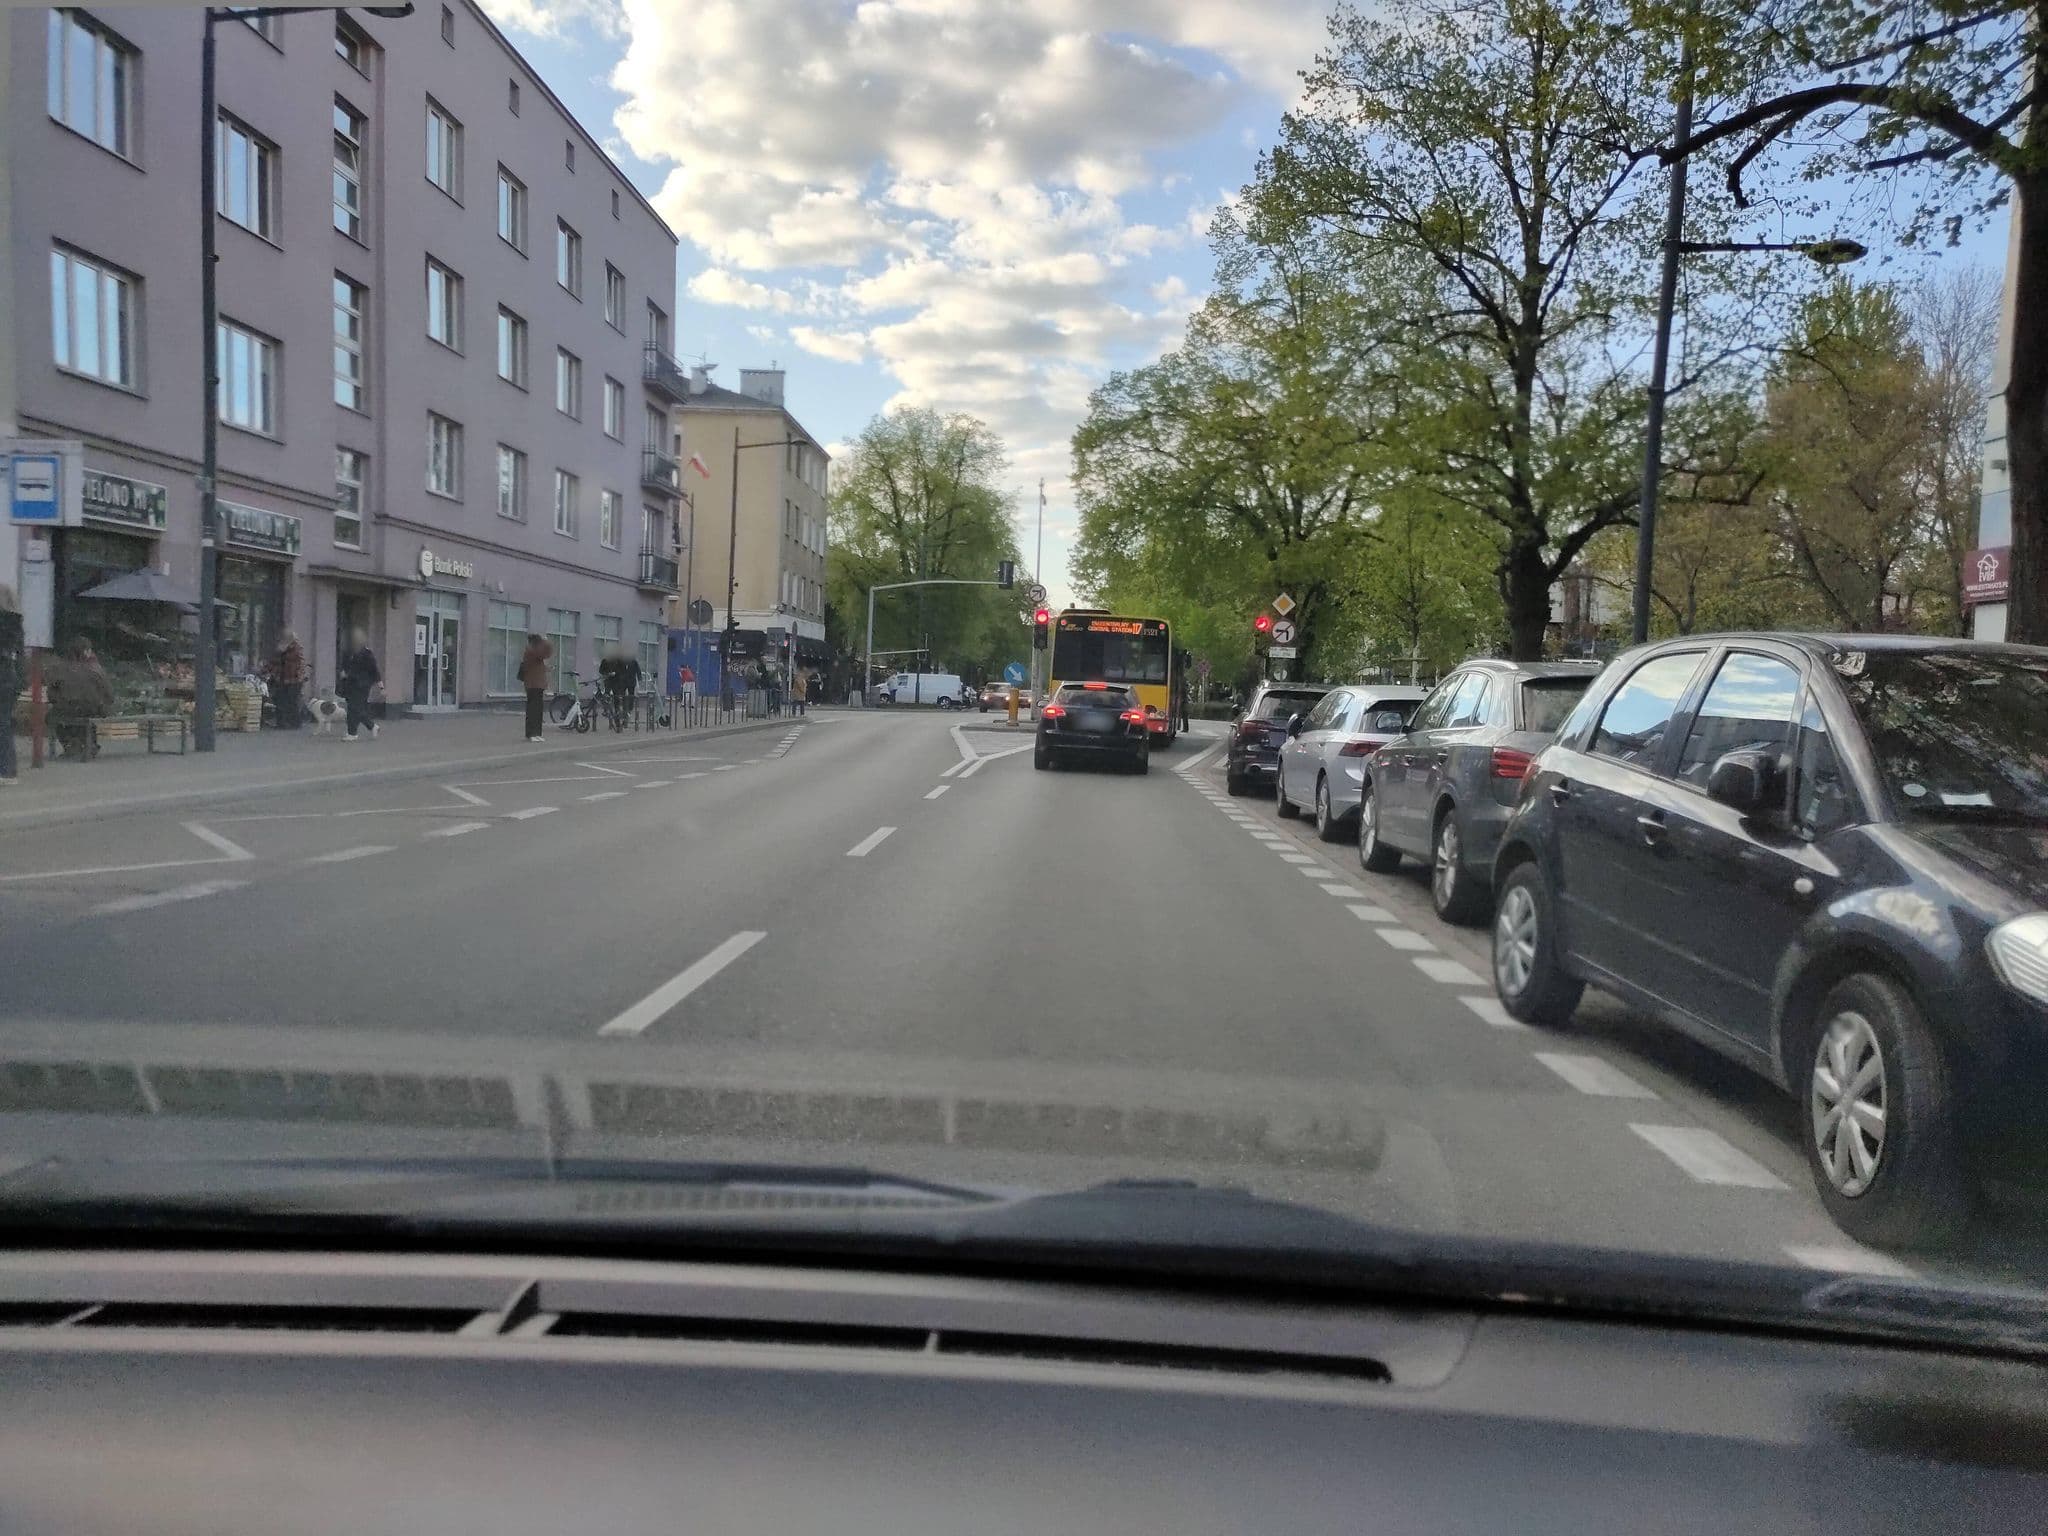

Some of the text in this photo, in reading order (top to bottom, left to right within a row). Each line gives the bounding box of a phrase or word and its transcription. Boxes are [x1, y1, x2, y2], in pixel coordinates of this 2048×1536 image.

[82, 479, 129, 507] IELONO
[434, 556, 473, 578] Bank Polski
